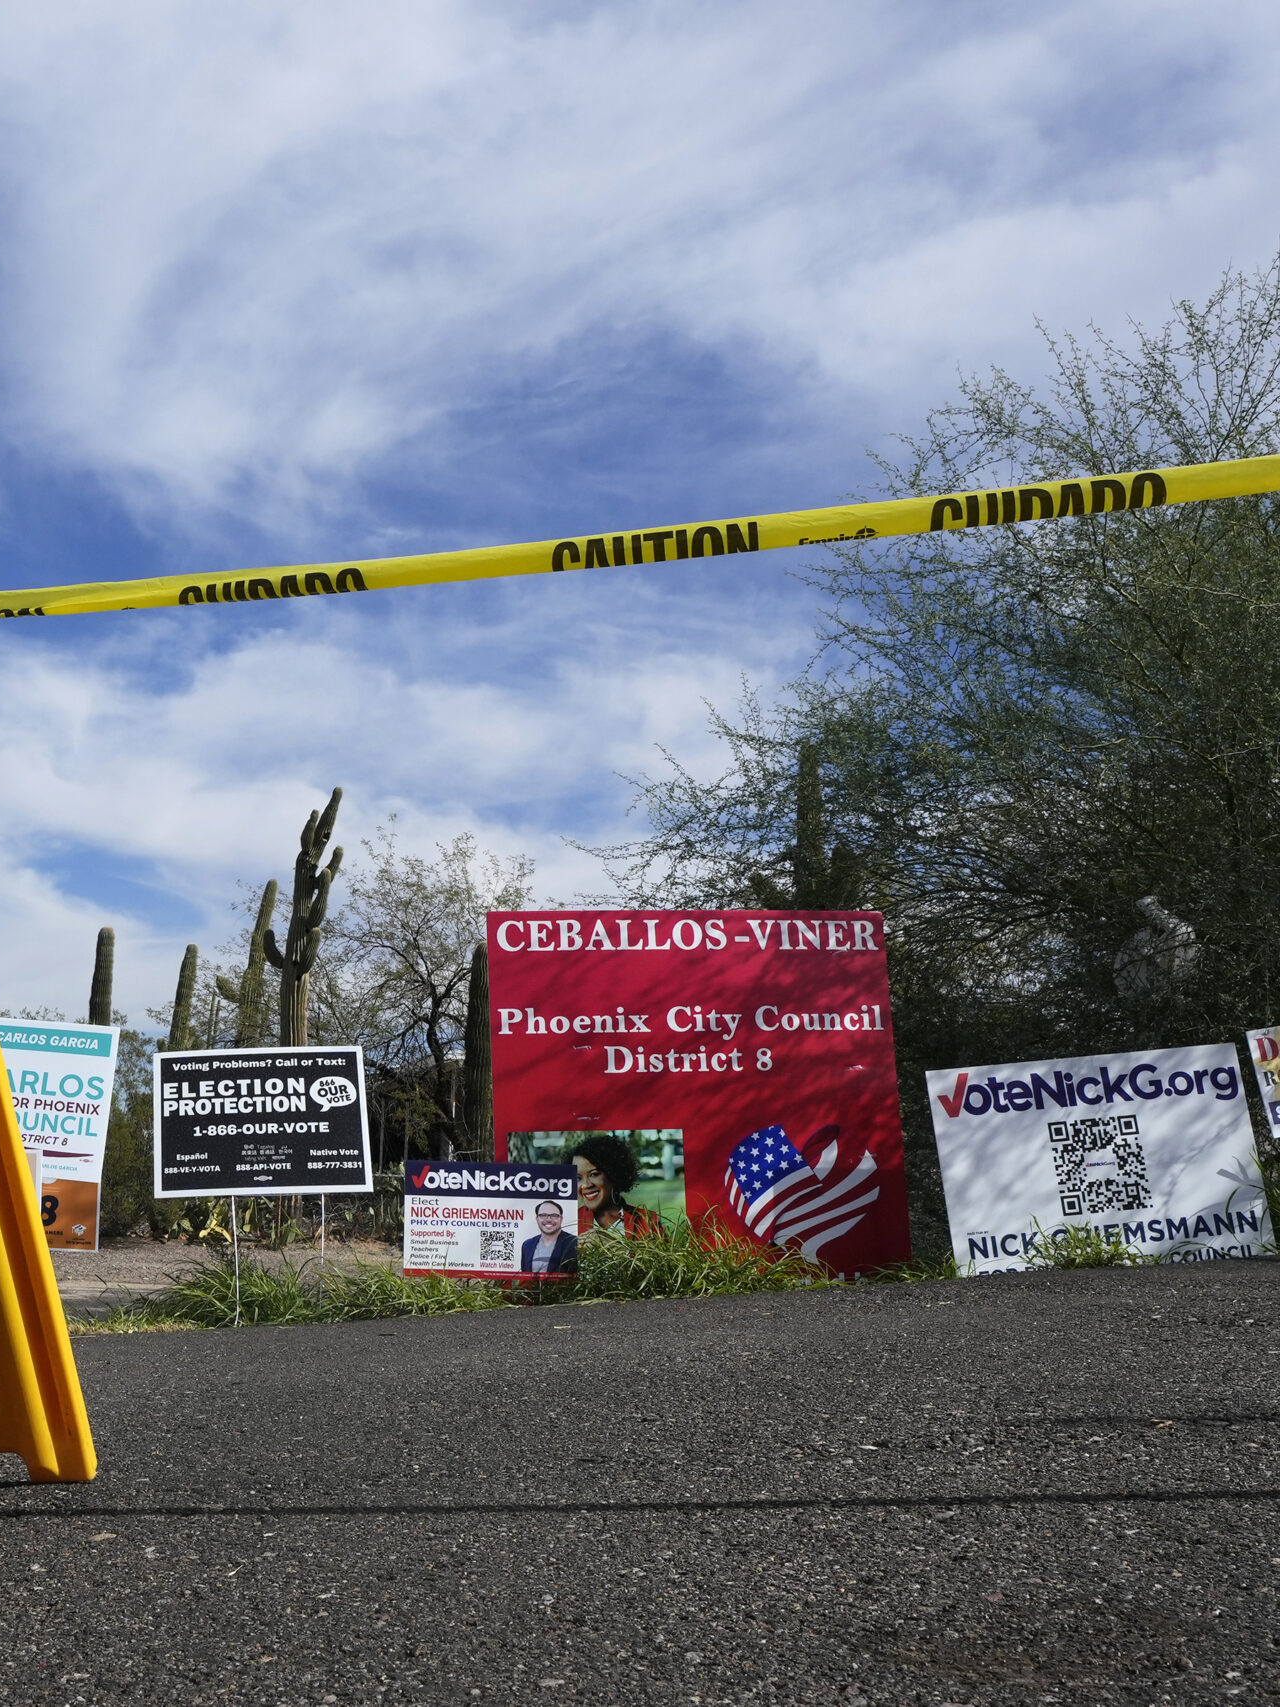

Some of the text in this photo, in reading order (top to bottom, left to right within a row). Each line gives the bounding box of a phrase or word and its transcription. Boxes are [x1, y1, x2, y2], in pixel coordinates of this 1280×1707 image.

[496, 918, 880, 952] CEBALLOS-VINER
[497, 1004, 884, 1041] Phoenix City Council
[50, 1036, 99, 1050] GARCIA
[172, 1057, 346, 1072] Voting Problems? Call or Text:
[604, 1045, 773, 1074] District 8
[163, 1077, 306, 1099] ELECTION
[319, 1079, 336, 1087] 866
[317, 1085, 349, 1098] OUR
[12, 1096, 101, 1115] OR PHOENIX
[326, 1094, 352, 1104] VOTE
[163, 1095, 307, 1117] PROTECTION
[193, 1121, 330, 1137] 1-866-OUR-VOTE
[21, 1134, 68, 1147] STRICT 8
[176, 1152, 208, 1162] Español
[310, 1148, 360, 1157] Native Vote
[164, 1165, 221, 1175] 888-VE-Y-VOTA
[236, 1162, 292, 1172] 888-API-VOTE
[307, 1161, 362, 1170] 888-777-3831
[411, 1197, 439, 1206] Elect
[410, 1206, 524, 1221] NICK GRIEMSMANN
[430, 1219, 450, 1227] CITY
[451, 1220, 490, 1228] COUNCIL
[491, 1221, 511, 1229] DIST
[410, 1229, 456, 1239] Supported By:
[410, 1245, 439, 1253] Teachers
[967, 1231, 1040, 1260] NICK
[480, 1261, 515, 1269] Watch Video
